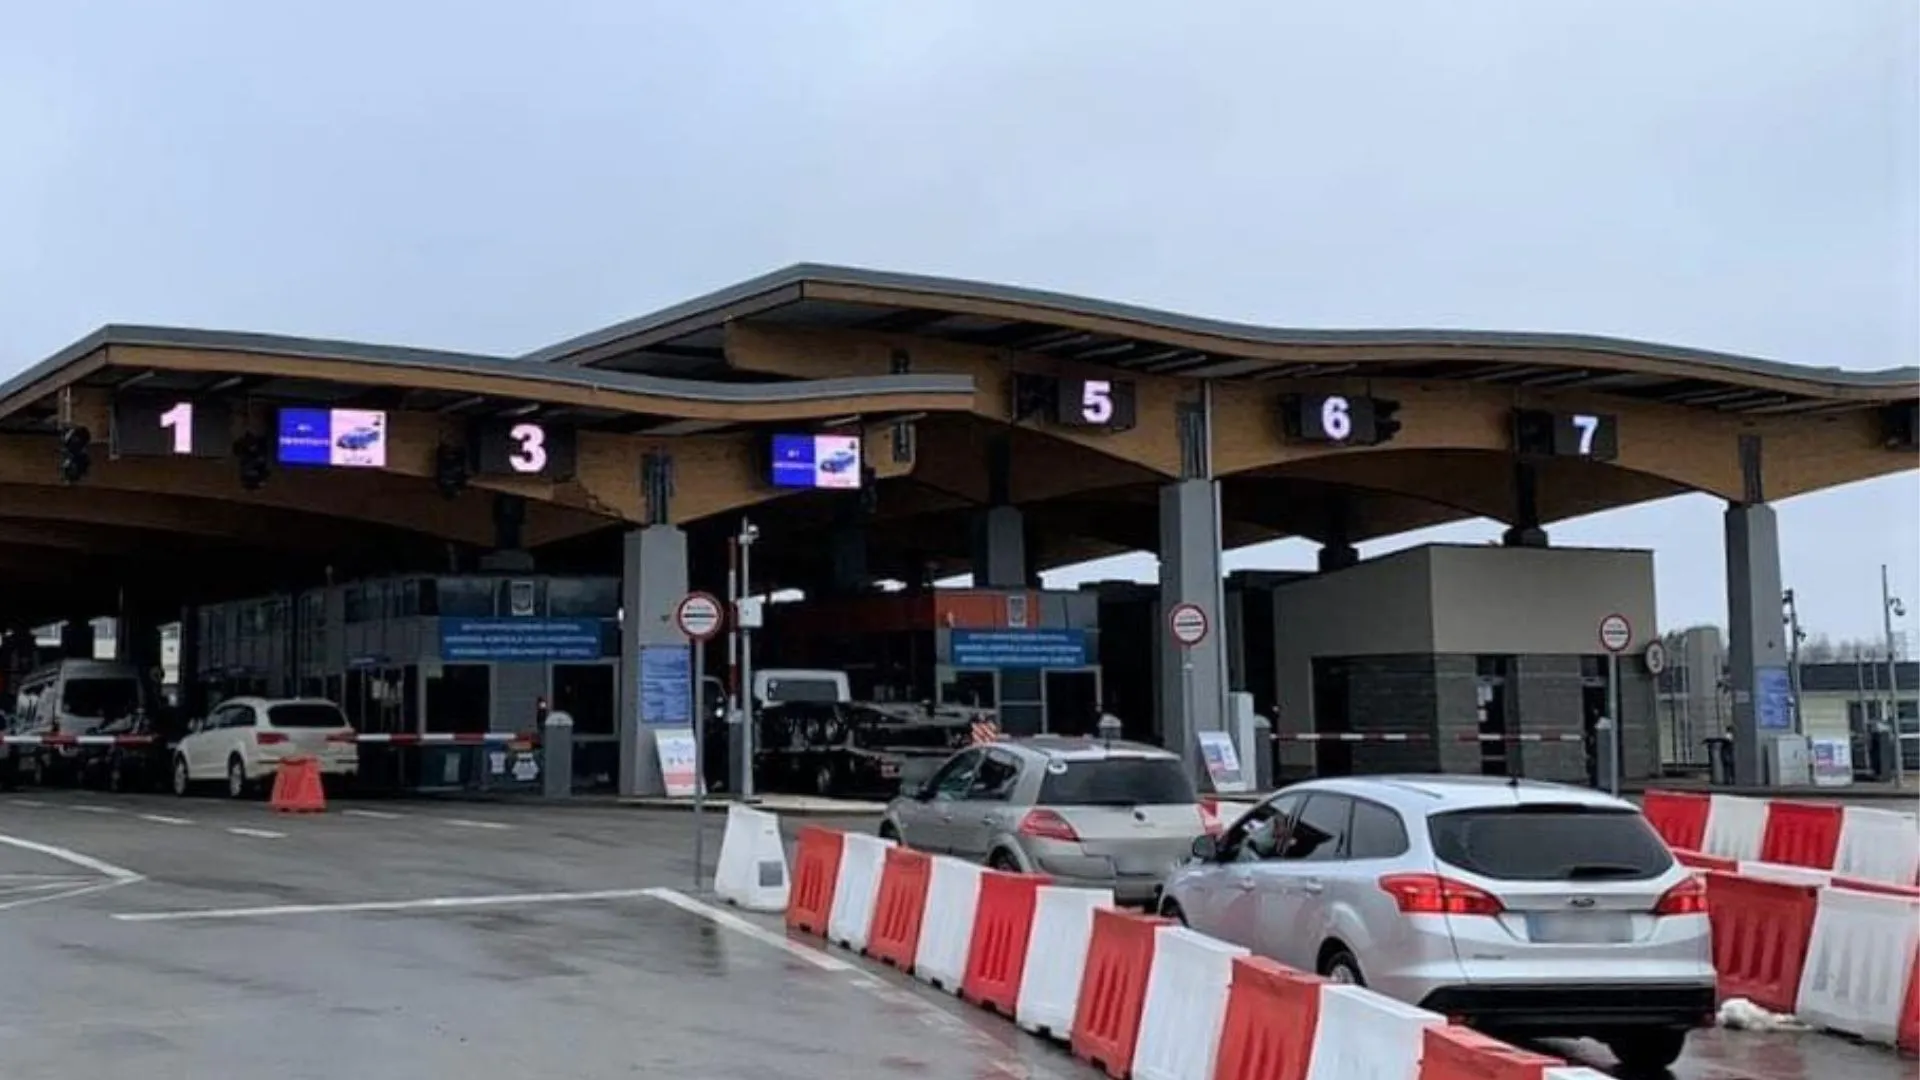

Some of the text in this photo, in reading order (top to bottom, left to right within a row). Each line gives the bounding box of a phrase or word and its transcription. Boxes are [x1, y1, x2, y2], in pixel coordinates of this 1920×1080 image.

[1083, 381, 1112, 422] 5
[1323, 397, 1350, 438] 6
[161, 403, 192, 453] 1
[510, 424, 546, 472] 3
[1574, 416, 1598, 454] 7
